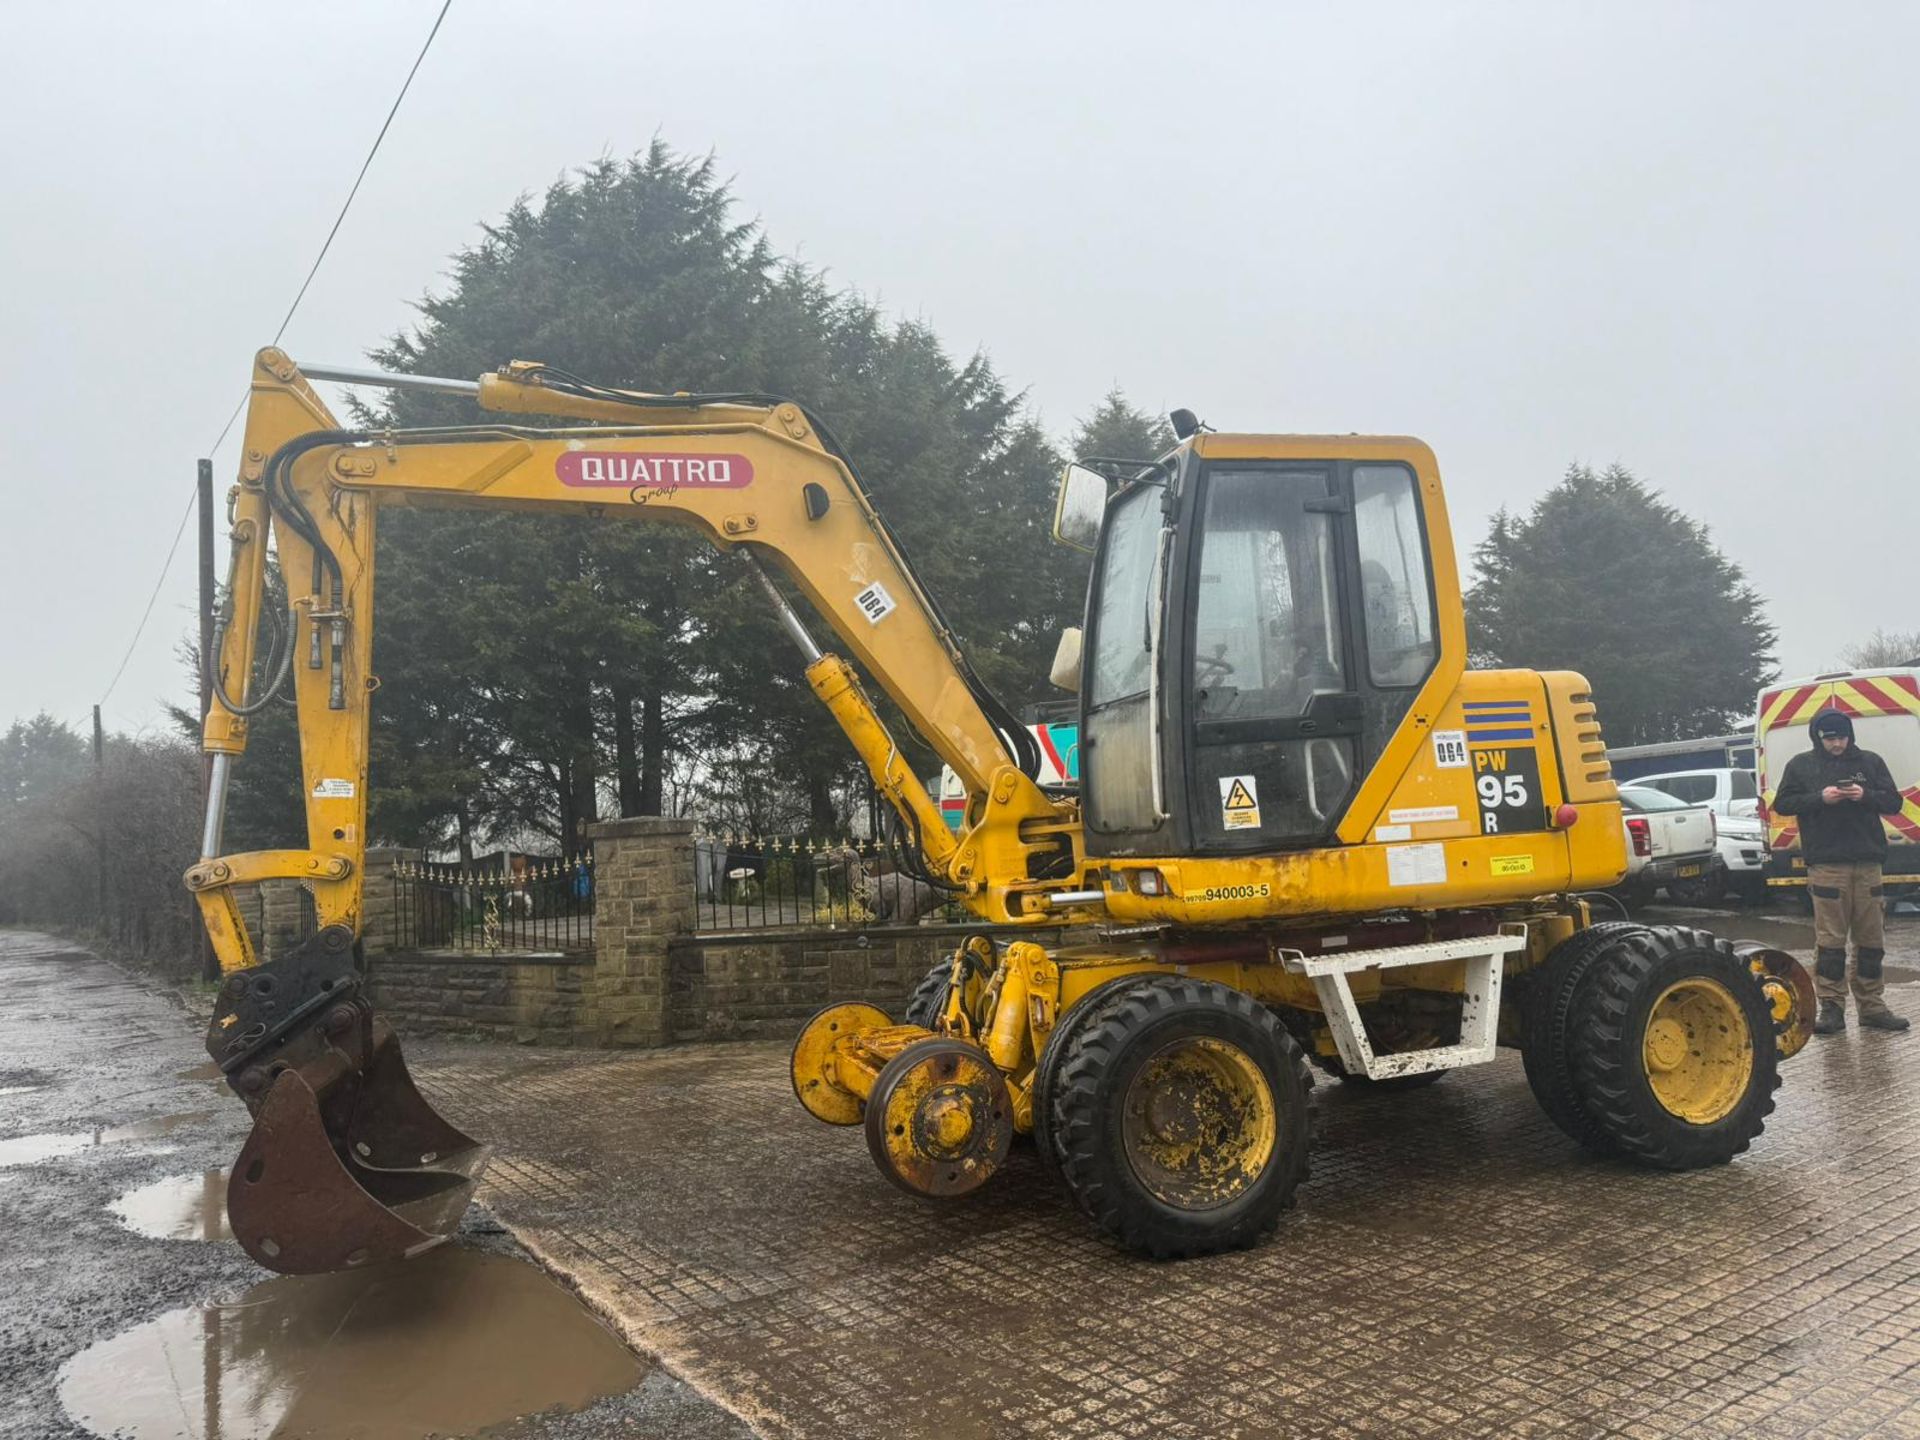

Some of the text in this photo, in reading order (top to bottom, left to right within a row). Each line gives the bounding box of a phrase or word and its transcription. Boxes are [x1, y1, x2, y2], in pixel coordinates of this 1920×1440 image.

[581, 457, 731, 483] QUATTRO
[630, 483, 678, 505] Group
[858, 590, 887, 620] 064
[1437, 742, 1465, 763] 064
[1475, 751, 1506, 772] PW
[1477, 774, 1528, 808] 95
[1485, 812, 1499, 833] R
[1206, 884, 1269, 901] 940003-5
